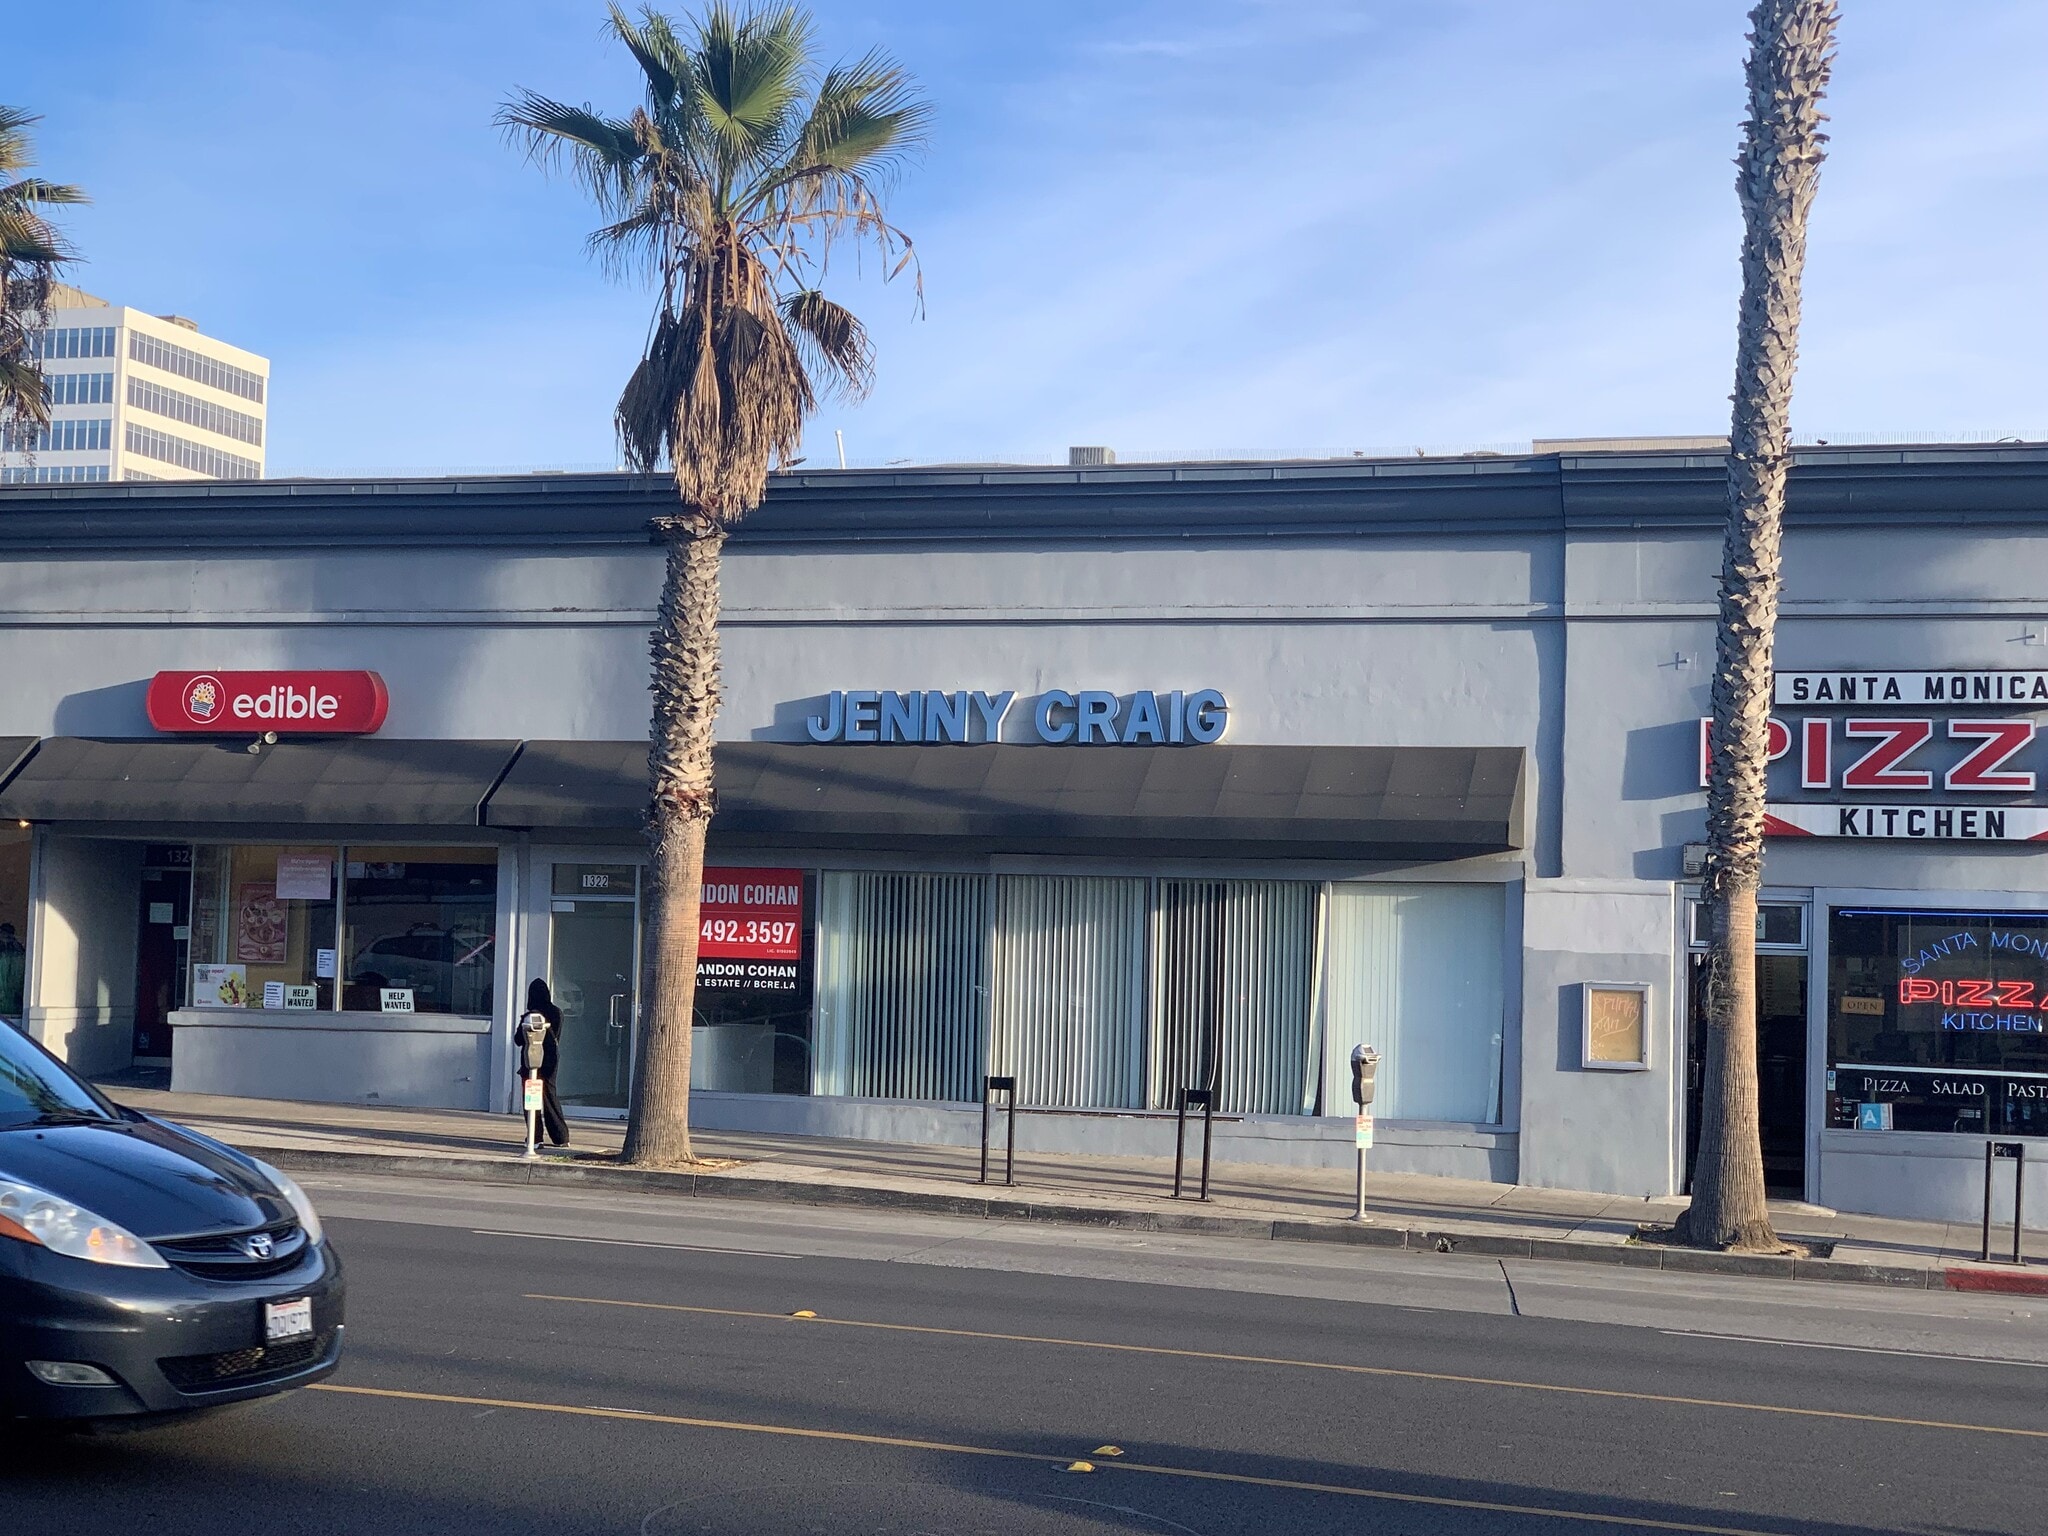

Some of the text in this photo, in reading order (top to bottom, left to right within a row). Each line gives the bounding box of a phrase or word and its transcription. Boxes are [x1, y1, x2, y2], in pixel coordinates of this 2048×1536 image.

[1793, 676, 2048, 700] SANTA MONICA
[232, 685, 339, 719] edible
[807, 689, 1230, 743] JENNY CRAIG
[1839, 808, 2005, 838] KITCHEN
[584, 875, 608, 887] 1322
[743, 884, 798, 906] COHAN
[701, 919, 796, 944] 492.3597
[1902, 931, 2048, 975] SANTA MON
[696, 963, 796, 977] ANDON COHAN
[292, 988, 310, 998] HELP
[705, 978, 740, 988] ESTATE
[754, 980, 796, 990] BCRE.LA
[1900, 978, 2048, 1010] PIZZ
[287, 998, 314, 1007] WANTED
[384, 1000, 412, 1011] WANTED
[388, 992, 406, 1001] HELP
[1847, 1001, 1878, 1010] OPEN
[1943, 1012, 2042, 1032] KITCHEN
[1863, 1077, 2048, 1099] PIZZA SALAD PAST
